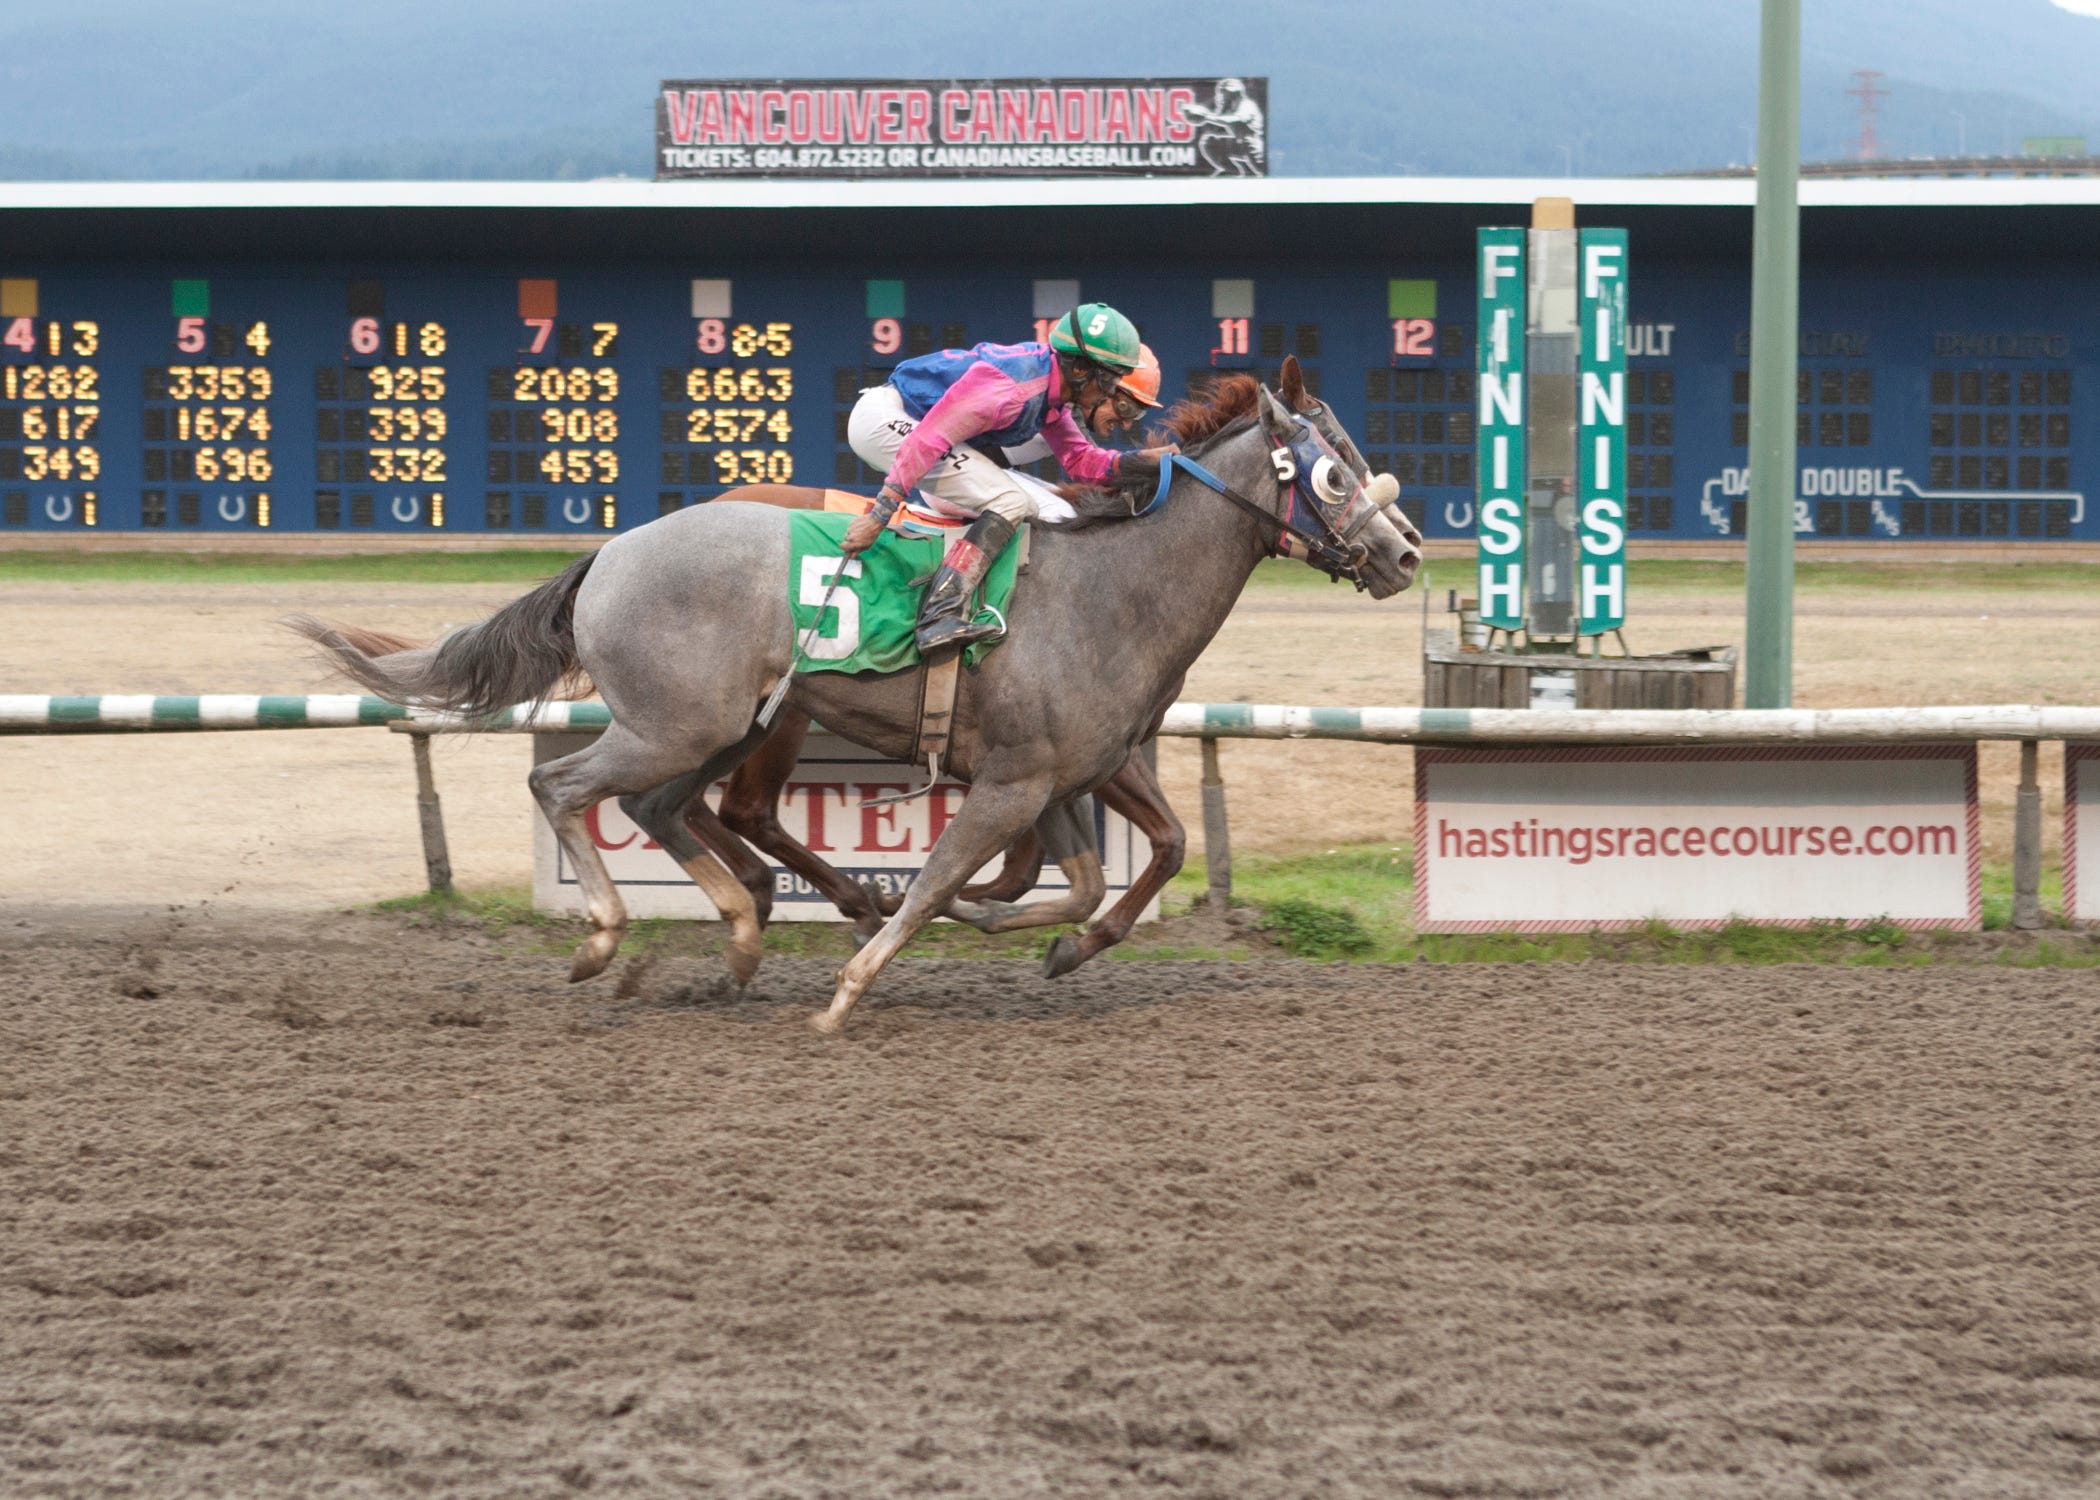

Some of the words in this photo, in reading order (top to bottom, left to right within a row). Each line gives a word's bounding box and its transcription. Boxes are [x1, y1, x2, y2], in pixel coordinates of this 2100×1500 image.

[664, 90, 932, 144] VANCOUVER
[940, 88, 1196, 144] CANADIANS
[662, 148, 750, 168] TICKETS:
[755, 148, 885, 168] 604.872.5232
[889, 148, 918, 167] OR
[921, 147, 1195, 167] CANADIANSBASEBALL.COM
[4, 318, 36, 352] 4
[49, 321, 99, 356] 13
[178, 318, 206, 352] 5
[246, 321, 271, 357] 4
[351, 318, 380, 354] 6
[396, 322, 446, 356] 18
[524, 318, 553, 354] 7
[592, 322, 618, 357] 7
[697, 318, 726, 354] 8
[873, 318, 902, 355] 9
[1087, 313, 1109, 336] 5
[1219, 318, 1249, 355] 11
[1393, 319, 1435, 355] 12
[5, 365, 99, 400] 1282
[168, 365, 272, 401] 3359
[368, 365, 446, 401] 925
[514, 367, 619, 402] 2089
[686, 367, 793, 402] 6663
[22, 405, 100, 440] 617
[178, 406, 272, 441] 1674
[369, 406, 447, 442] 399
[541, 407, 619, 443] 908
[687, 408, 793, 443] 2574
[1480, 246, 1522, 618] FINISH
[1582, 246, 1625, 618] FINISH
[23, 445, 100, 481] 349
[195, 447, 273, 482] 696
[369, 447, 447, 482] 332
[540, 449, 619, 484] 459
[713, 449, 793, 484] 930
[1270, 447, 1296, 480] 5
[1802, 468, 1903, 496] DOUBLE
[258, 493, 270, 527] 1
[431, 493, 444, 527] 1
[797, 555, 862, 660] 5
[1438, 818, 1957, 864] hastingsracecourse.com
